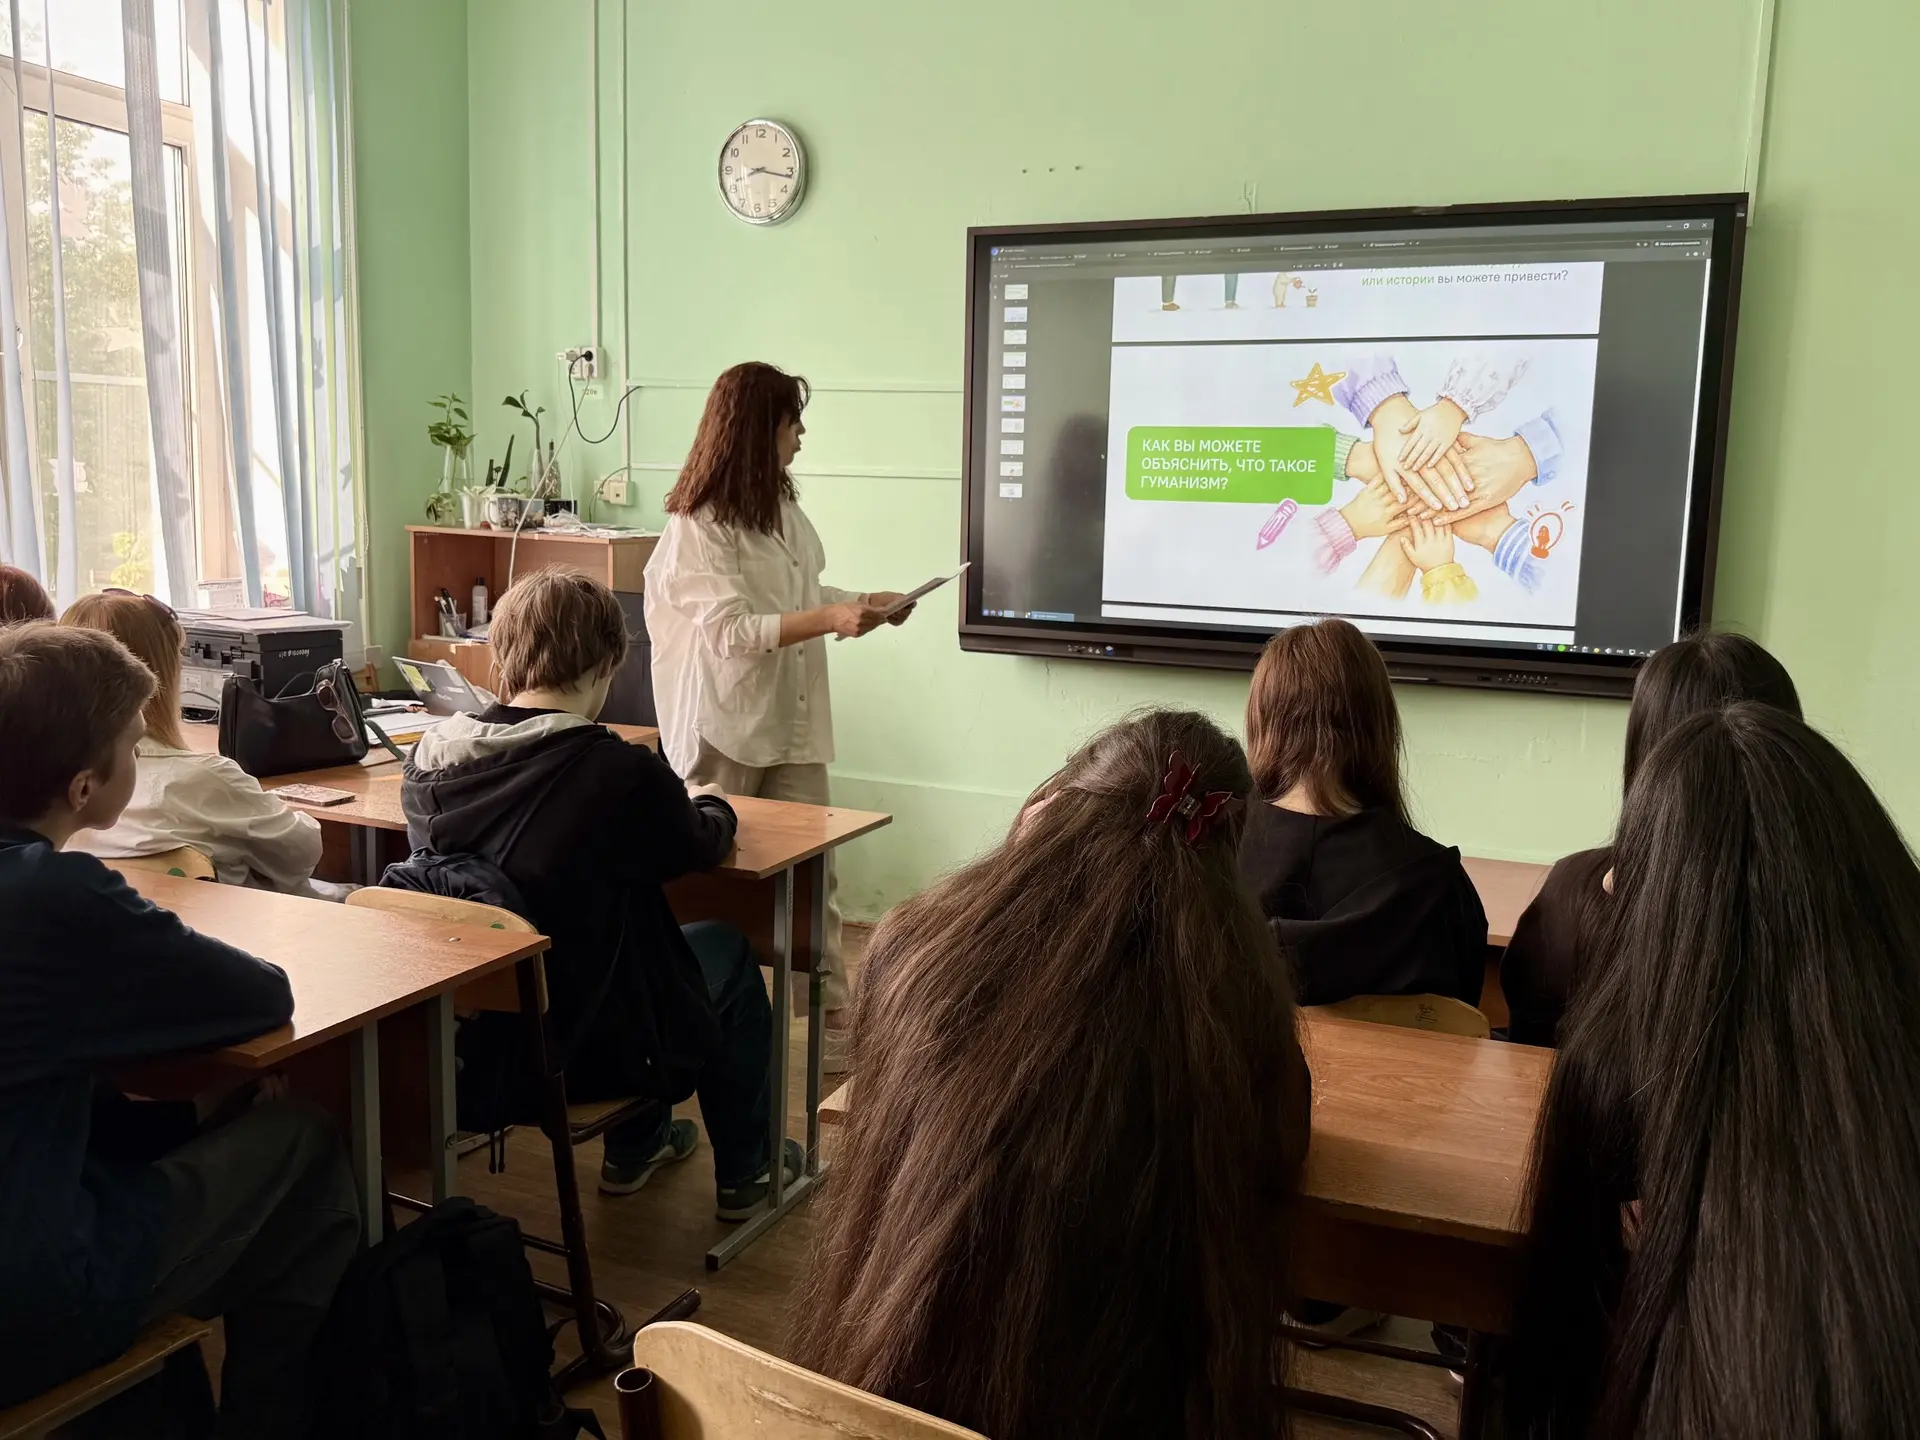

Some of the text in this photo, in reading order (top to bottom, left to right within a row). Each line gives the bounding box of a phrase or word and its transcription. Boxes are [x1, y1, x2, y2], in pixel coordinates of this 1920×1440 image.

[742, 134, 749, 144] 11
[755, 129, 767, 139] 12
[730, 148, 739, 158] 10
[782, 148, 791, 158] 2
[724, 165, 733, 175] 9
[786, 167, 794, 176] 3
[729, 184, 738, 194] 8
[780, 184, 788, 194] 4
[739, 198, 746, 208] 7
[753, 203, 761, 213] 6
[768, 198, 777, 208] 5
[1361, 269, 1569, 288] или истории вы можете привести?
[1142, 439, 1262, 453] КАК ВЫ МОЖЕТЕ
[1141, 457, 1317, 474] ОБЪЯСНИТЬ, ЧТО ТАКОЕ
[1140, 476, 1229, 490] ГУМАНИЗМ?
